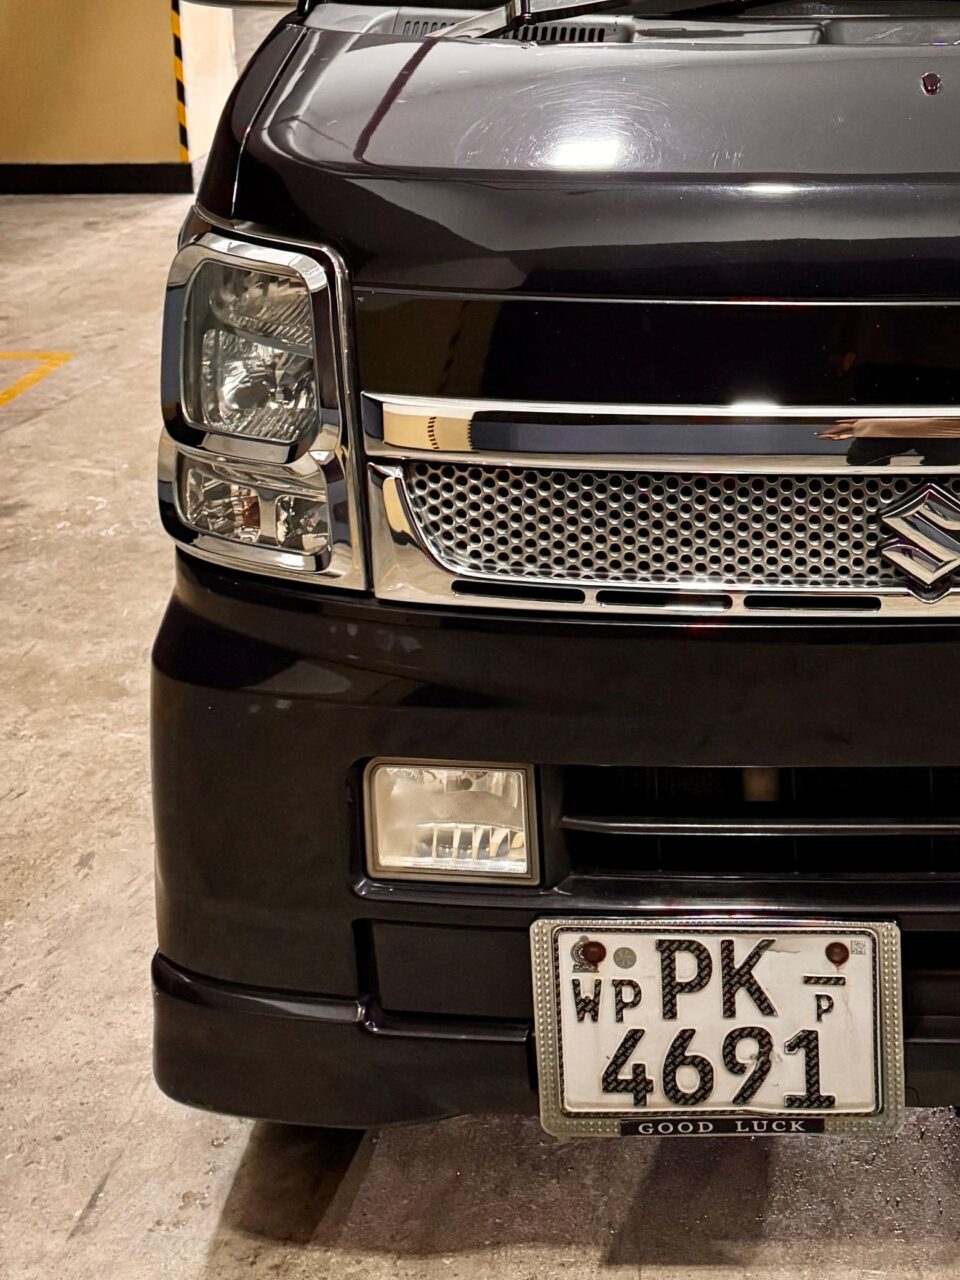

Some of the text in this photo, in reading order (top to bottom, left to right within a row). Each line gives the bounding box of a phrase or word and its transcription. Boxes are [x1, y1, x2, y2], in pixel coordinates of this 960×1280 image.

[815, 994, 834, 1021] P
[602, 1027, 836, 1108] 4691
[638, 1120, 806, 1135] GOOD LUCK
